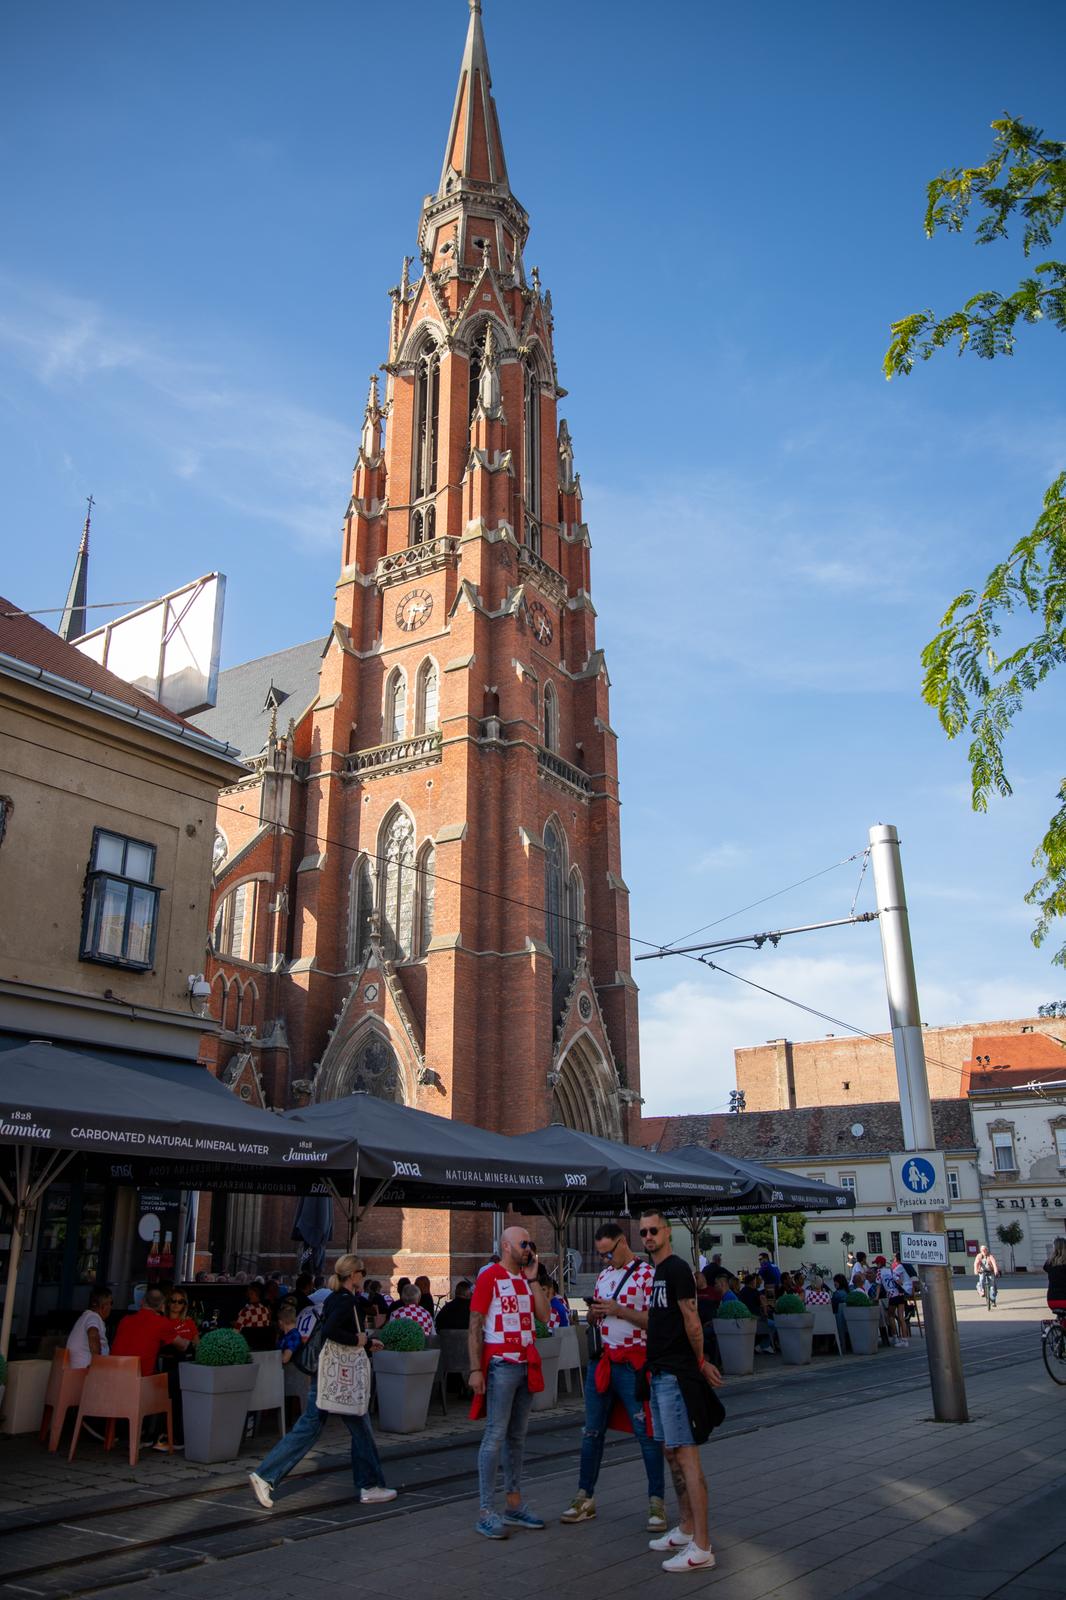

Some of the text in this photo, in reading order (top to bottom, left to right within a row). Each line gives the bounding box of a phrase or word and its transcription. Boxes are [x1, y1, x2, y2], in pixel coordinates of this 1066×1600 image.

[11, 1111, 32, 1121] 1828
[70, 1127, 269, 1155] CARBONATED NATURAL MINERAL WATER
[282, 1147, 328, 1162] Jamnica
[391, 1160, 422, 1178] Jana
[445, 1169, 545, 1185] NATURAL MINERAL WATER
[564, 1173, 588, 1187] Jana
[907, 1237, 937, 1247] Dostava
[920, 1251, 927, 1259] do
[502, 1296, 518, 1313] 33
